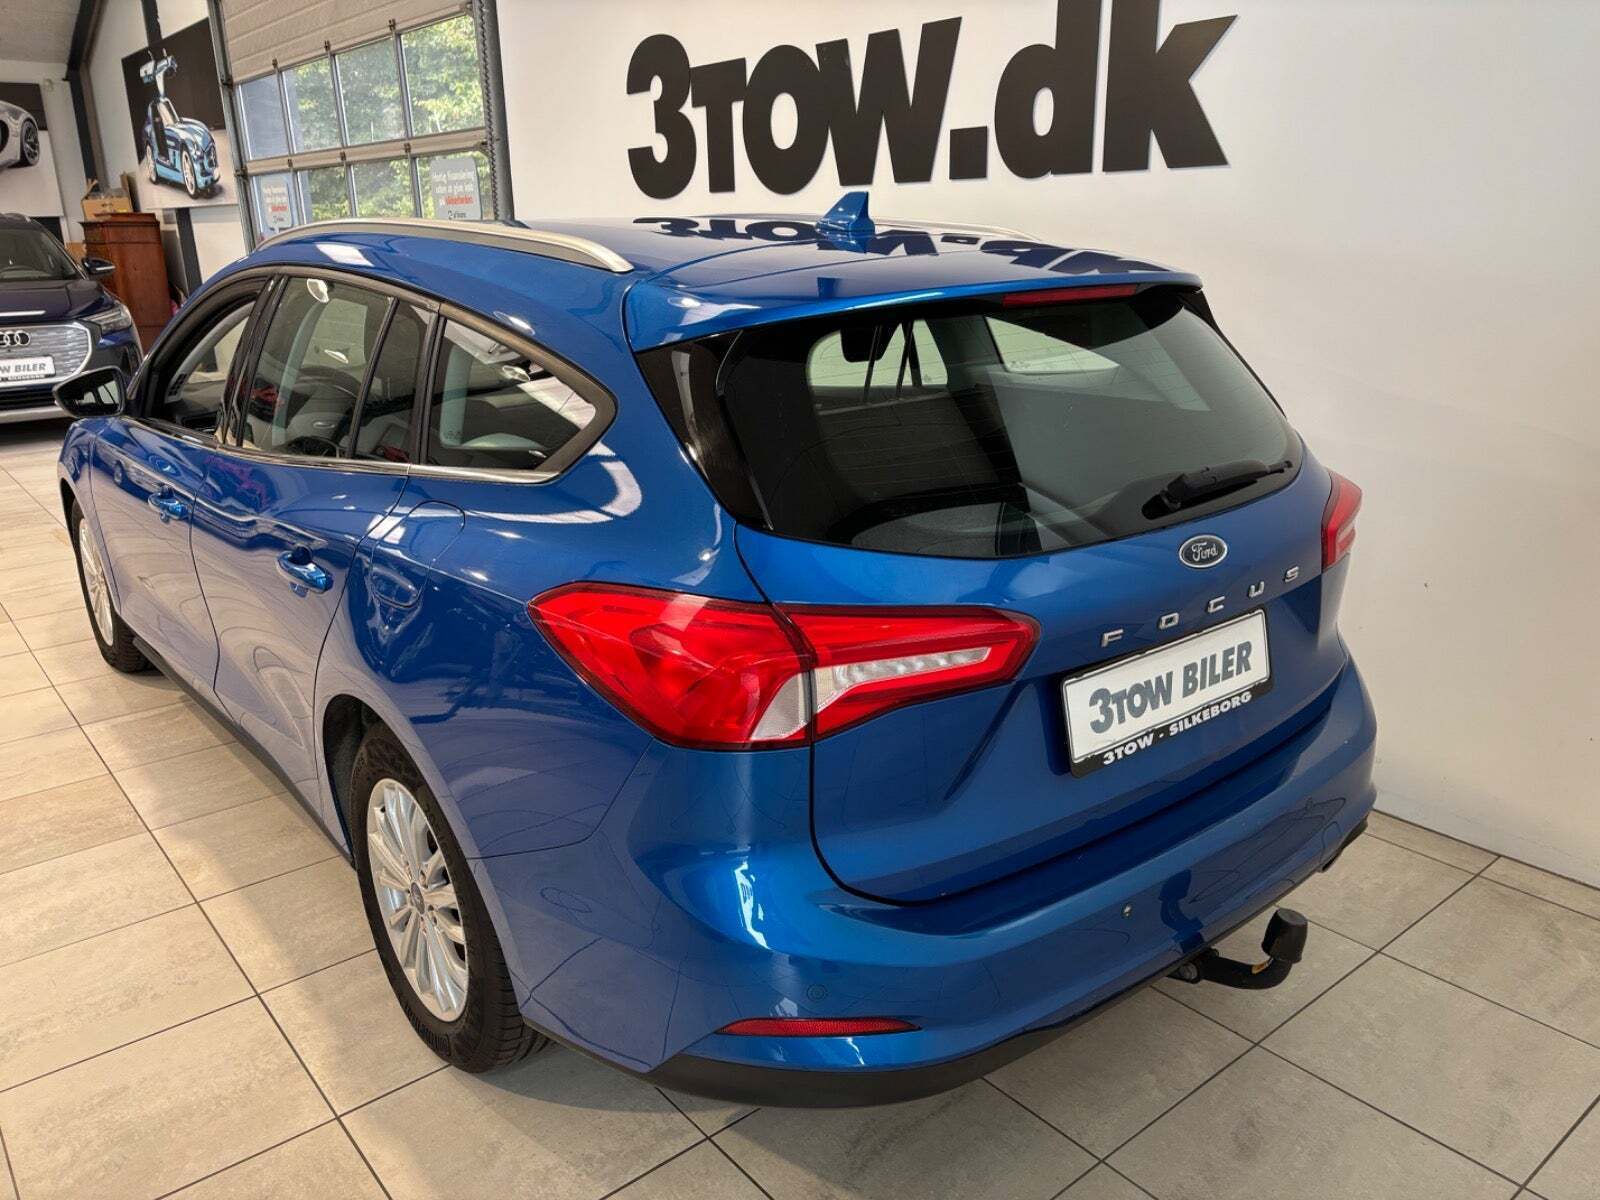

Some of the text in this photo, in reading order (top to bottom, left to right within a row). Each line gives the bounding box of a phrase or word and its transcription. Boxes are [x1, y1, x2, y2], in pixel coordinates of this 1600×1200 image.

[626, 0, 1238, 199] 3TOW.dk
[15, 363, 46, 372] BILER
[1191, 541, 1218, 562] Ford
[1100, 566, 1300, 648] FOCUS
[1089, 640, 1253, 734] 3TOW BILER
[1102, 733, 1154, 766] 3TOW
[1168, 691, 1253, 737] SILKEBORG
